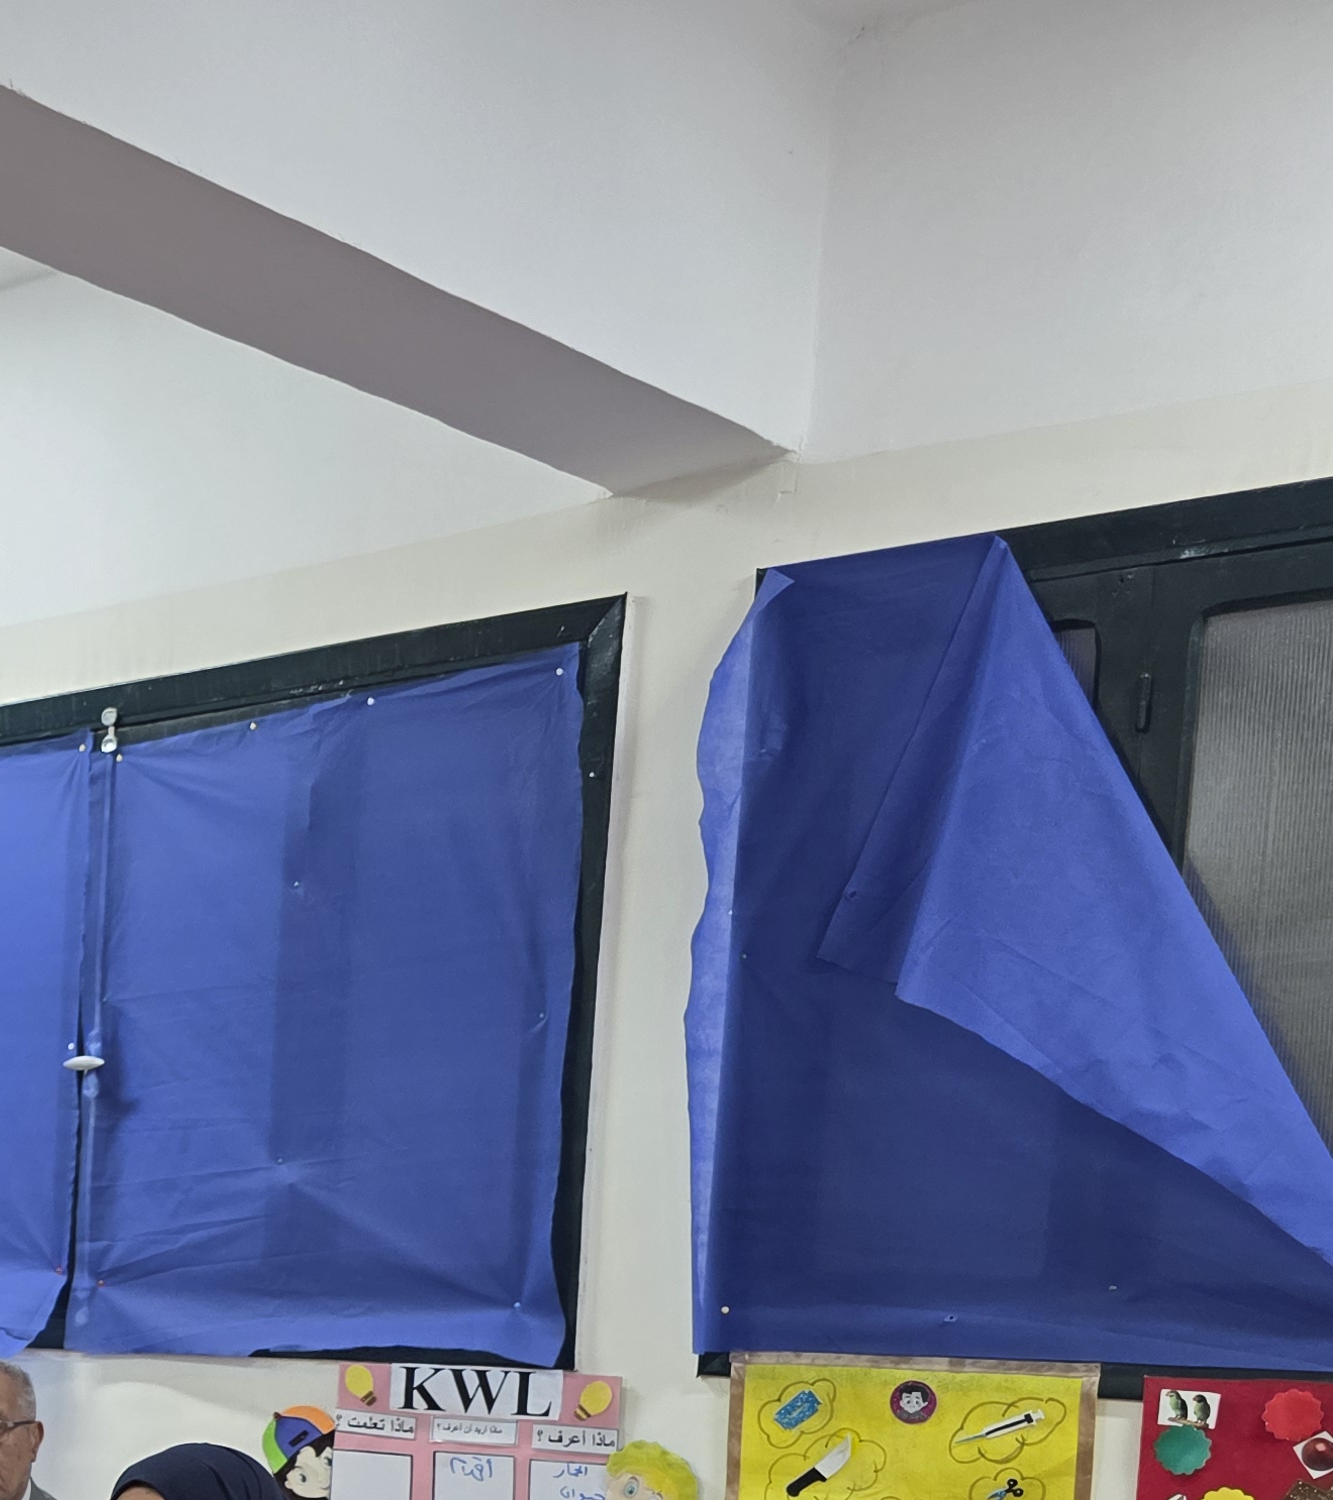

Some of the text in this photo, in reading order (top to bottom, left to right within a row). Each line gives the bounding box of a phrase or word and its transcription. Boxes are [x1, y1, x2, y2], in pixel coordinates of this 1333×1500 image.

[398, 1366, 555, 1418] KWL
[390, 1416, 414, 1433] ماذا
[548, 1430, 585, 1447] أعرف
[592, 1432, 615, 1447] ماذا
